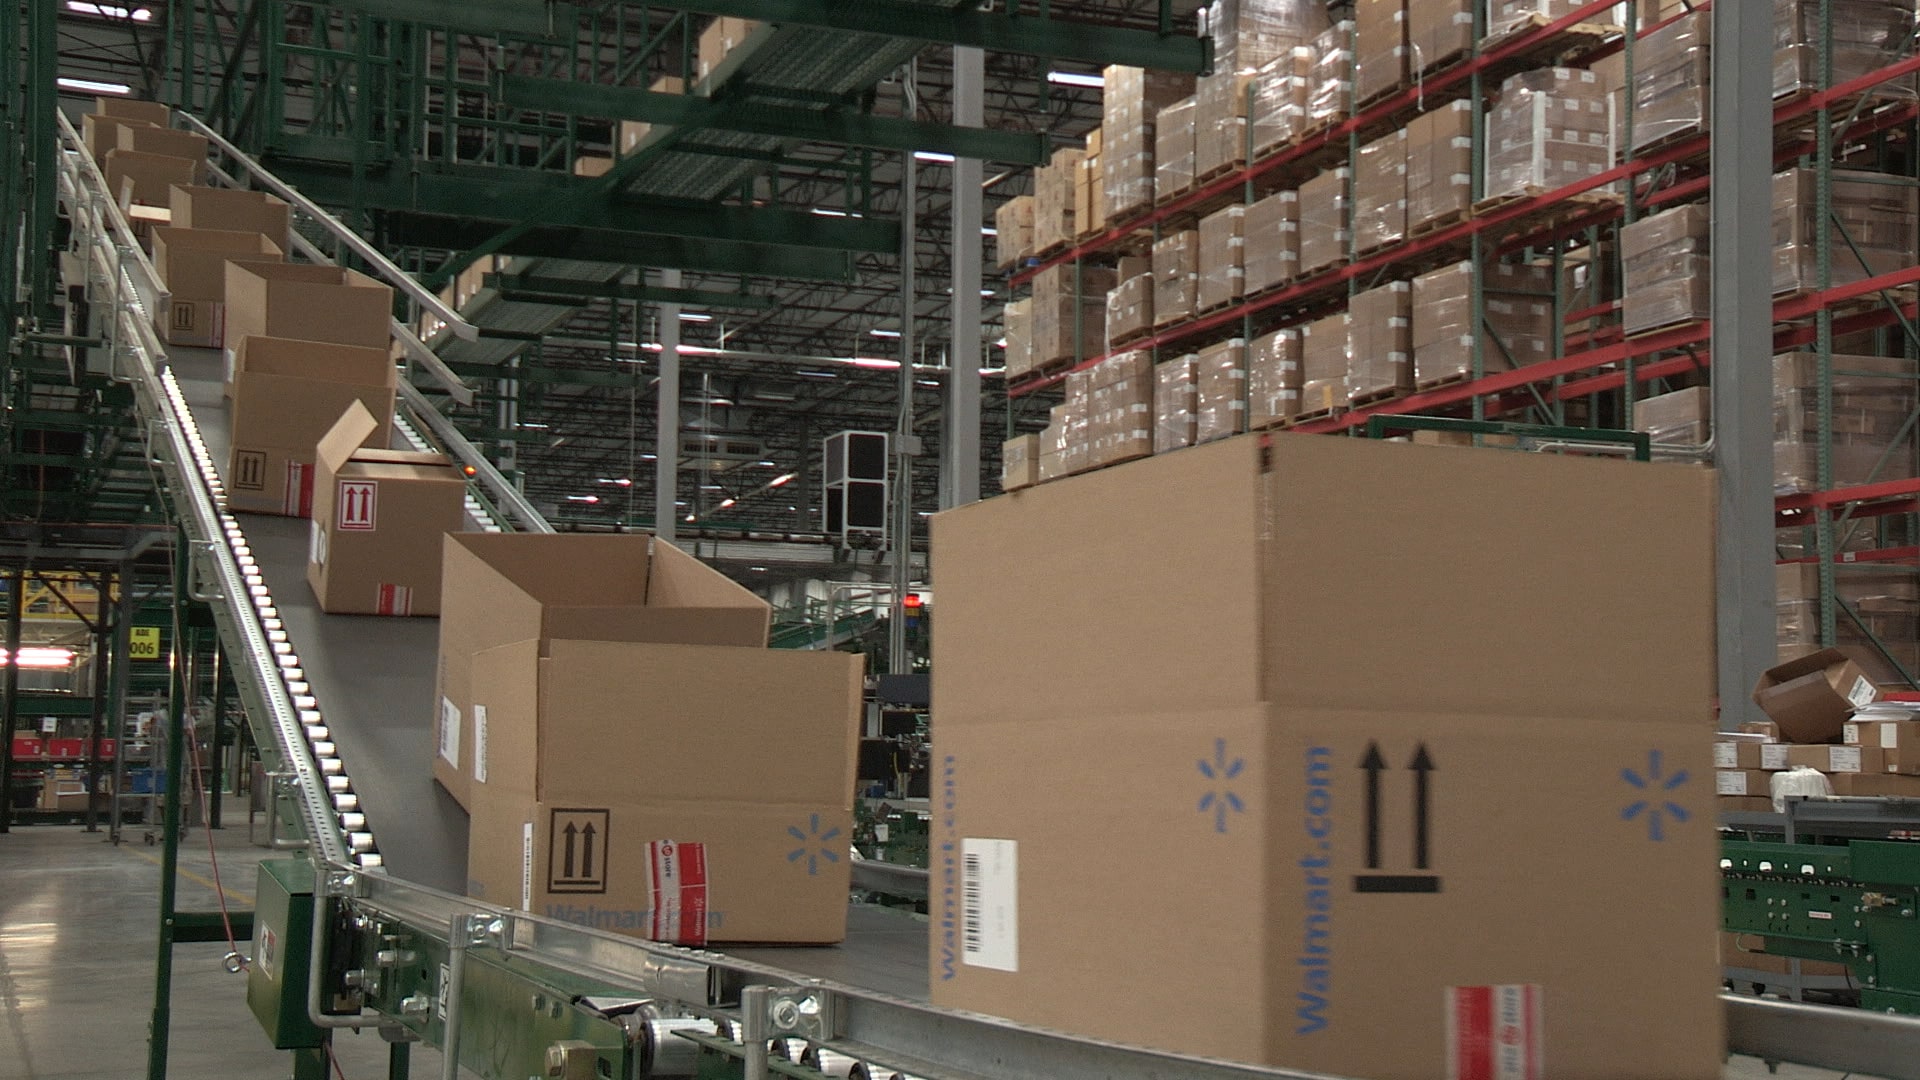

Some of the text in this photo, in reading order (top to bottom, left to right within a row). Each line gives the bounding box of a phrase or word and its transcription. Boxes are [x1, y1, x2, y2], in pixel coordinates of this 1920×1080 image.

[129, 642, 155, 654] 006
[546, 904, 722, 929] Walmarm
[941, 755, 956, 982] Walmart.com
[1295, 746, 1330, 1036] Walmart.com
